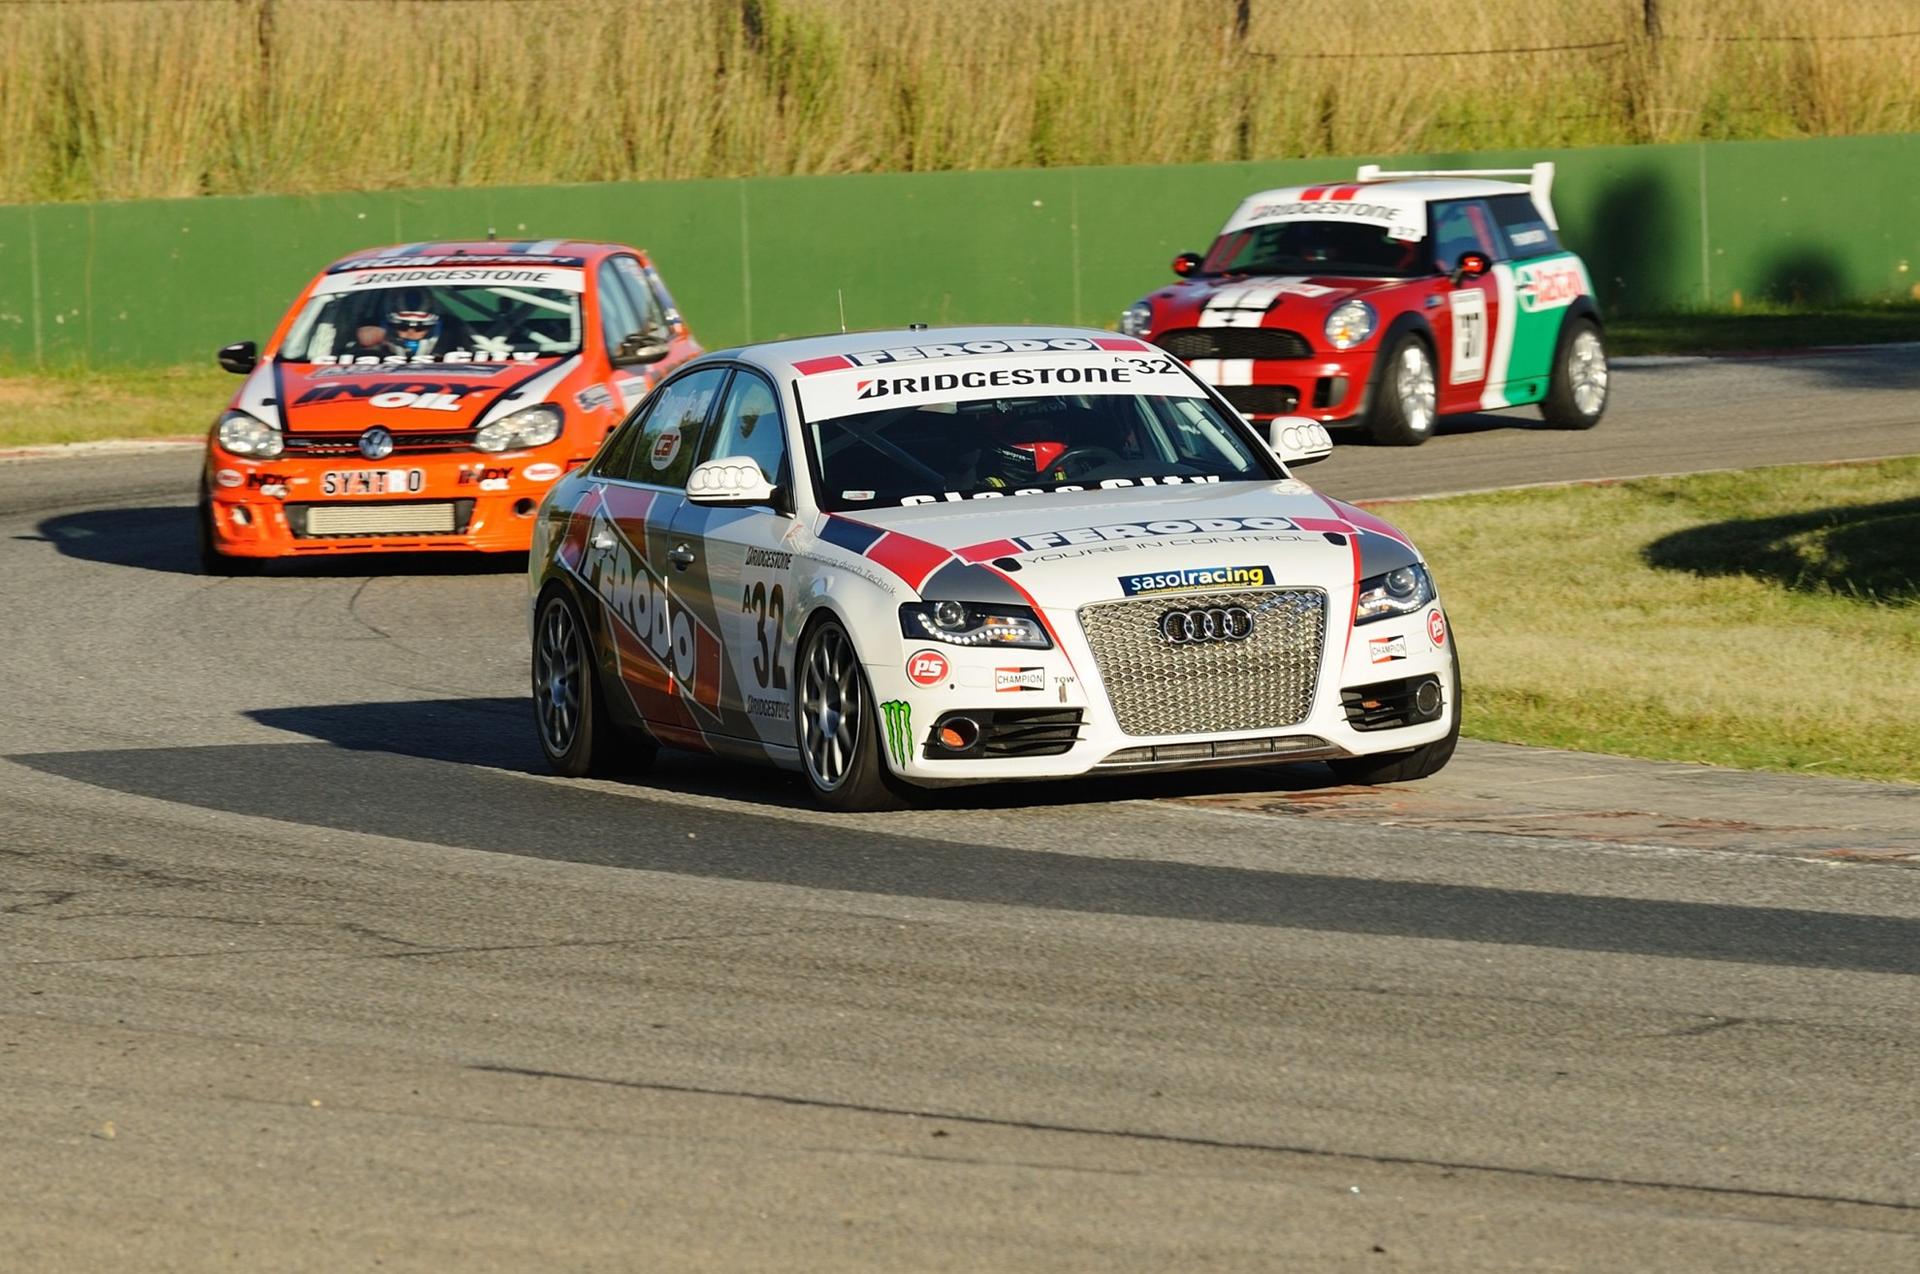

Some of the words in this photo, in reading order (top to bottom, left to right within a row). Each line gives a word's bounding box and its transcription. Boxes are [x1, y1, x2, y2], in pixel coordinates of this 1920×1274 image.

[1251, 201, 1400, 222] BRIDGESTONE
[355, 270, 552, 286] BRIDGESTONE
[858, 338, 1093, 366] FERODO
[857, 367, 1132, 400] BRIDGESTONE
[368, 391, 463, 412] OIL
[1018, 517, 1292, 551] FERODO
[1136, 541, 1163, 550] IN
[1168, 535, 1321, 547] CONTROL
[745, 545, 793, 571] BRIDGESTONE
[863, 569, 898, 598] Technik
[582, 513, 694, 681] FERODO
[913, 659, 944, 677] PS
[997, 674, 1043, 685] CHAMPION
[1054, 676, 1075, 684] TOW
[747, 694, 791, 720] BRIDGESTONE
